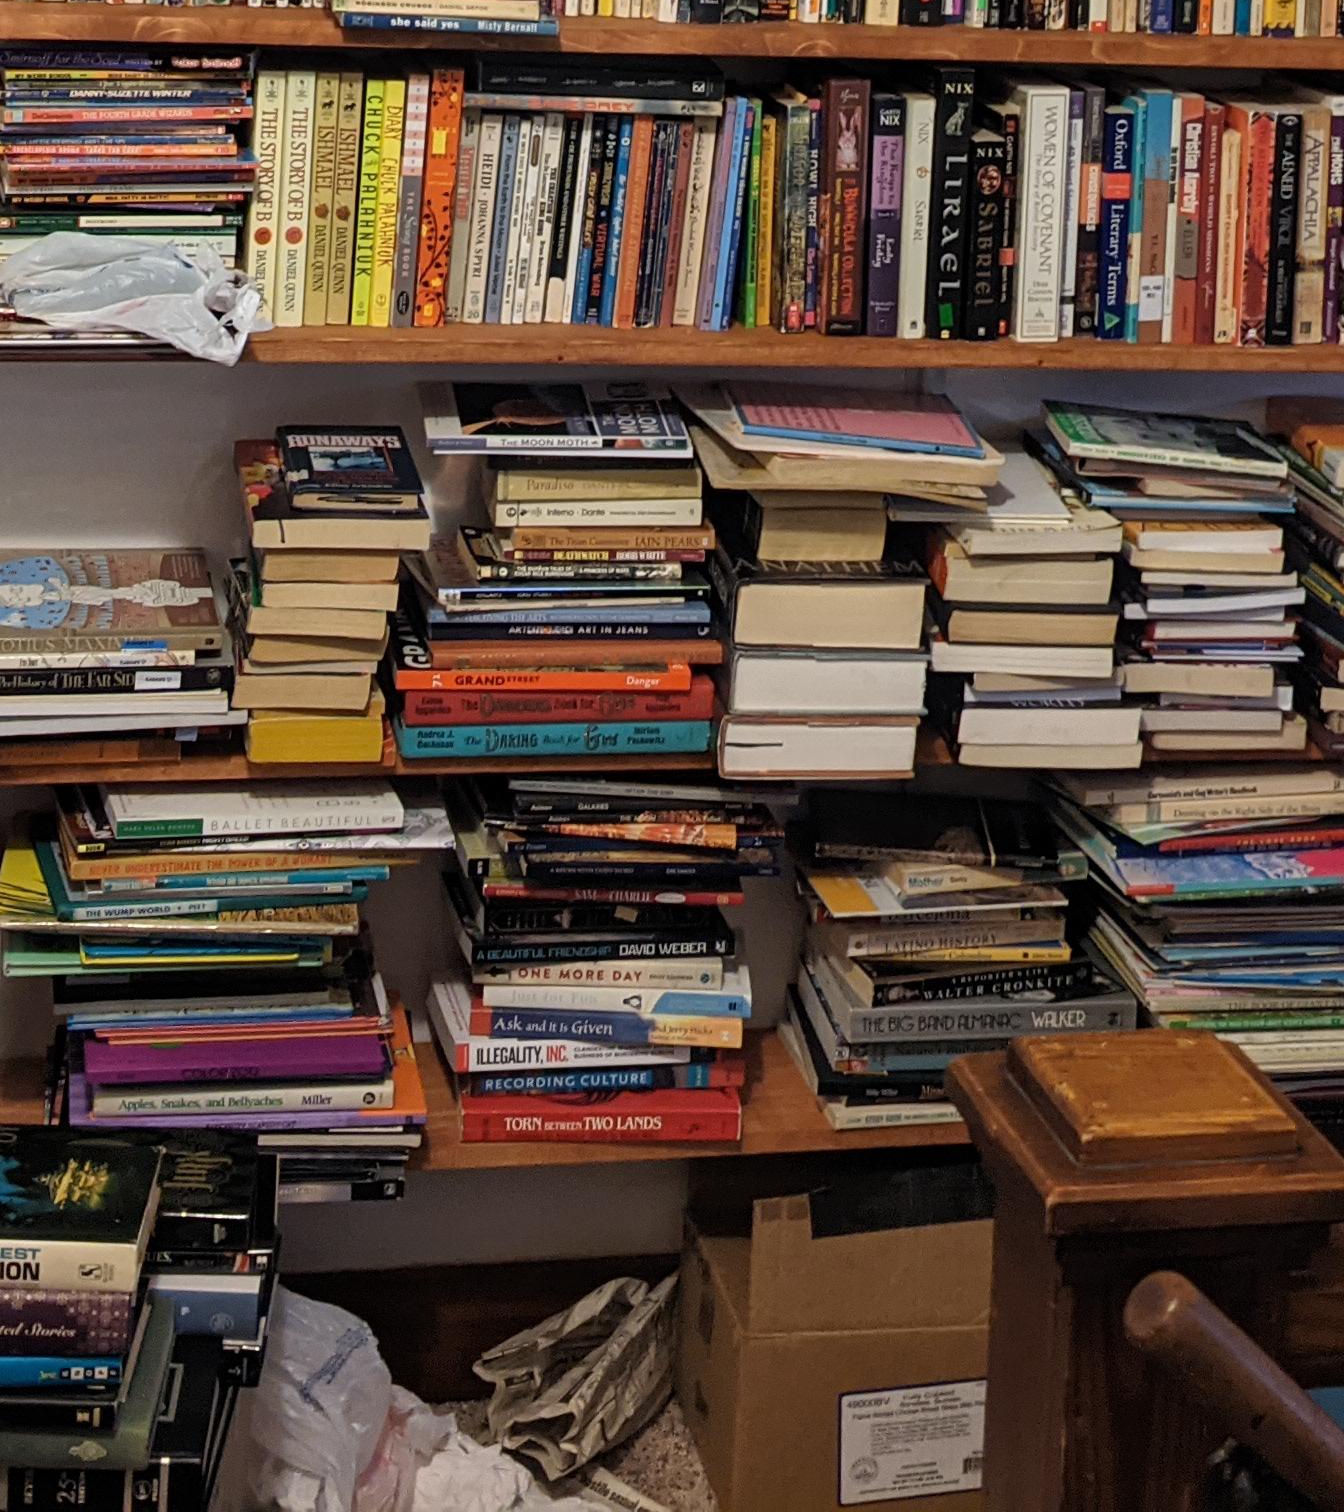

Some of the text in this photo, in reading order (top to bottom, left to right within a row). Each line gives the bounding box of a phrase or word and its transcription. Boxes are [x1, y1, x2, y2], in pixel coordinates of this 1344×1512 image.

[390, 16, 411, 28] she
[415, 17, 439, 28] said
[441, 20, 460, 30] yes
[945, 83, 973, 94] NIX
[387, 106, 403, 141] DIARY
[880, 116, 900, 126] NIX
[315, 125, 335, 193] ISHMAEL
[976, 148, 1003, 158] NIX
[357, 95, 383, 277] CHUCK PALAHNIUK
[1107, 120, 1129, 306] Oxford Literary Terms
[520, 438, 554, 447] MOON
[557, 438, 589, 447] MOTH
[664, 536, 701, 548] PEARS
[455, 675, 505, 686] GRAND
[626, 675, 661, 688] Danger
[211, 818, 273, 831] BALLET
[619, 943, 655, 956] DAVID
[658, 941, 706, 955] WEBER
[518, 967, 642, 982] ONE MORE DAY
[546, 1045, 568, 1063] INC.
[485, 1072, 647, 1090] RECORDING CULTURE
[300, 1093, 332, 1106] Miller
[504, 1117, 542, 1131] TORN
[583, 1116, 614, 1130] TWO
[616, 1115, 662, 1130] LANDS
[25, 1323, 77, 1339] Stories
